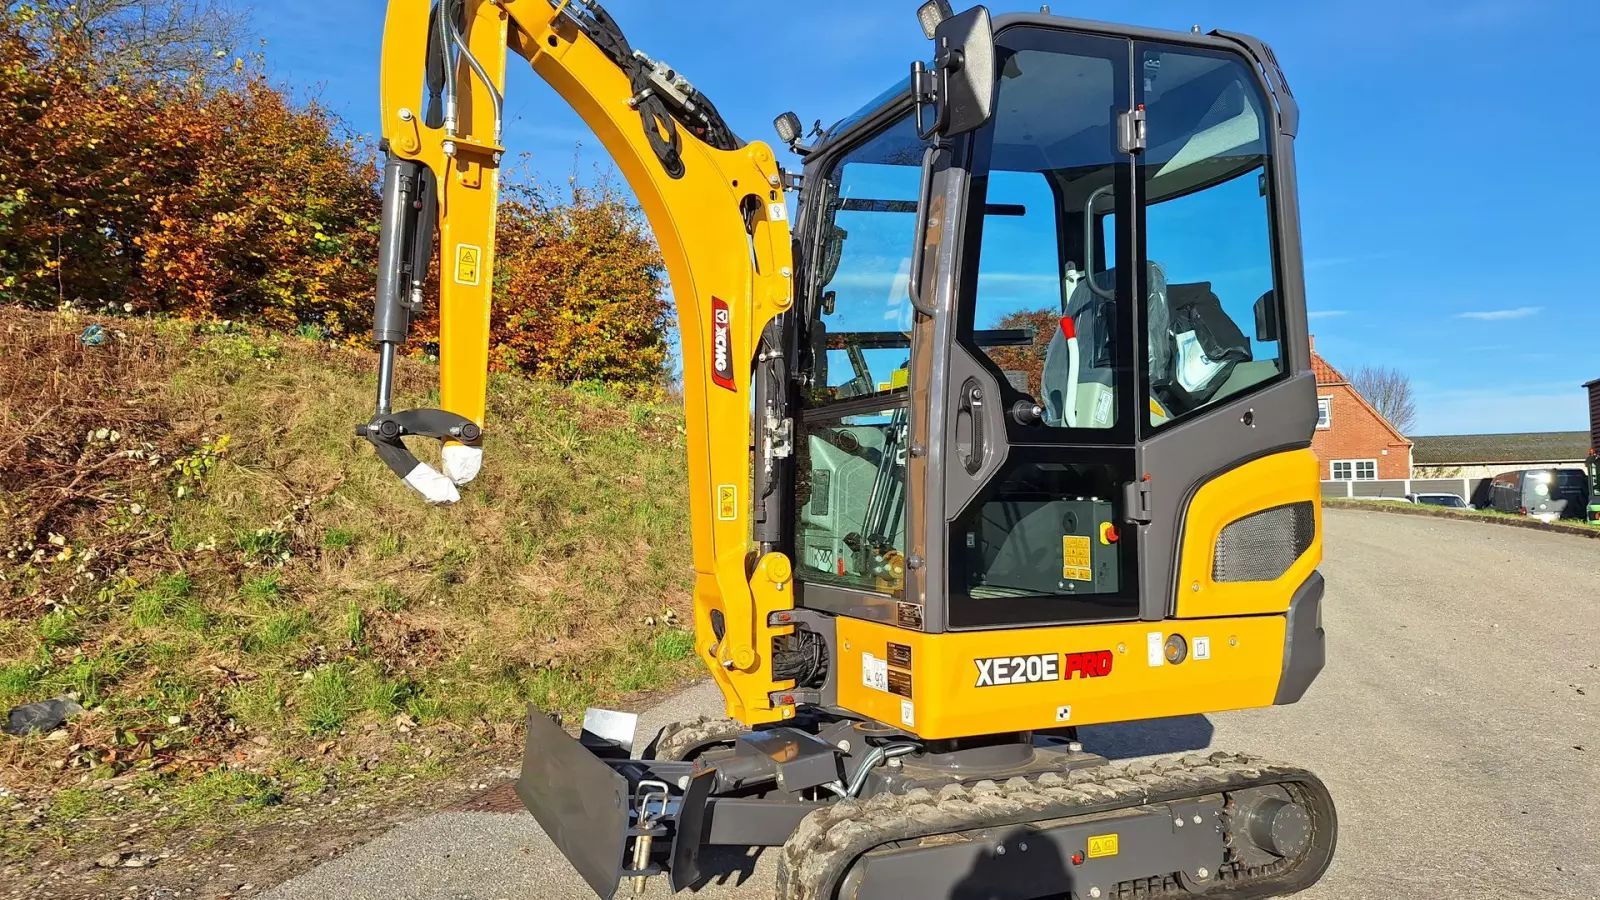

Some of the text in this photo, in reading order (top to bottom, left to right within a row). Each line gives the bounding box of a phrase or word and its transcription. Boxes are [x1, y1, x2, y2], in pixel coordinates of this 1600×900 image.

[715, 323, 727, 371] XCMG
[974, 650, 1114, 687] XE20E PRO
